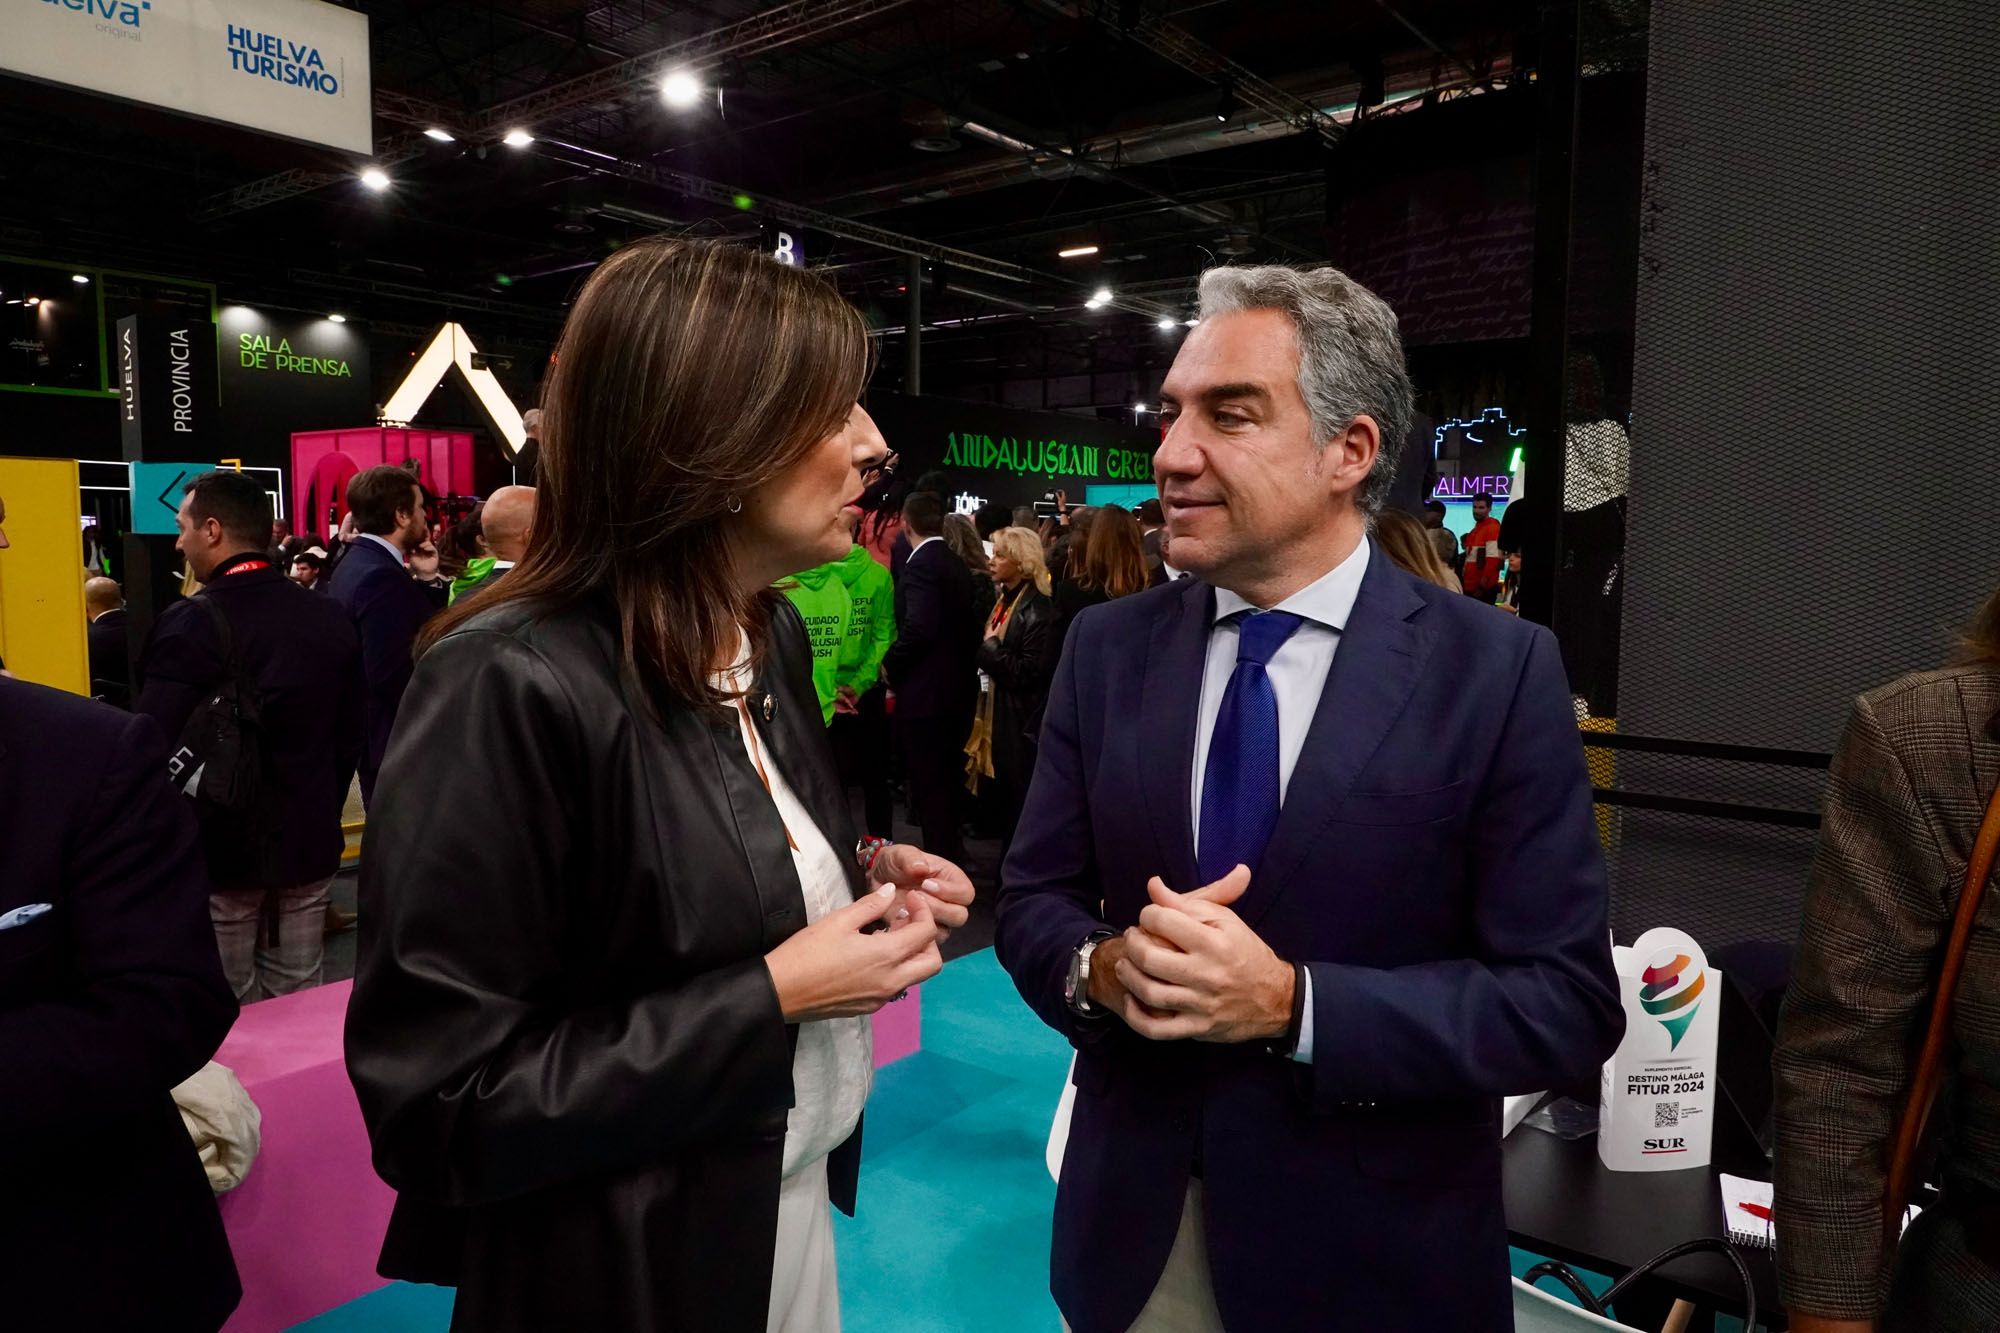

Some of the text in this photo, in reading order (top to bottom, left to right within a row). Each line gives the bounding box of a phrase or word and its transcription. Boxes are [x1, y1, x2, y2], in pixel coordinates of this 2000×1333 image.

[227, 23, 325, 71] HUELVA
[227, 46, 338, 95] TURISMO
[774, 231, 795, 265] B
[240, 333, 292, 354] SALA
[121, 328, 134, 420] HUELVA
[240, 352, 352, 377] DE PRENSA
[170, 329, 192, 432] PROVINCIA
[825, 628, 835, 636] EL
[1627, 1081, 1704, 1095] FITUR 2024
[1671, 1072, 1704, 1081] MÁLAGA
[1643, 1137, 1686, 1150] SUR
